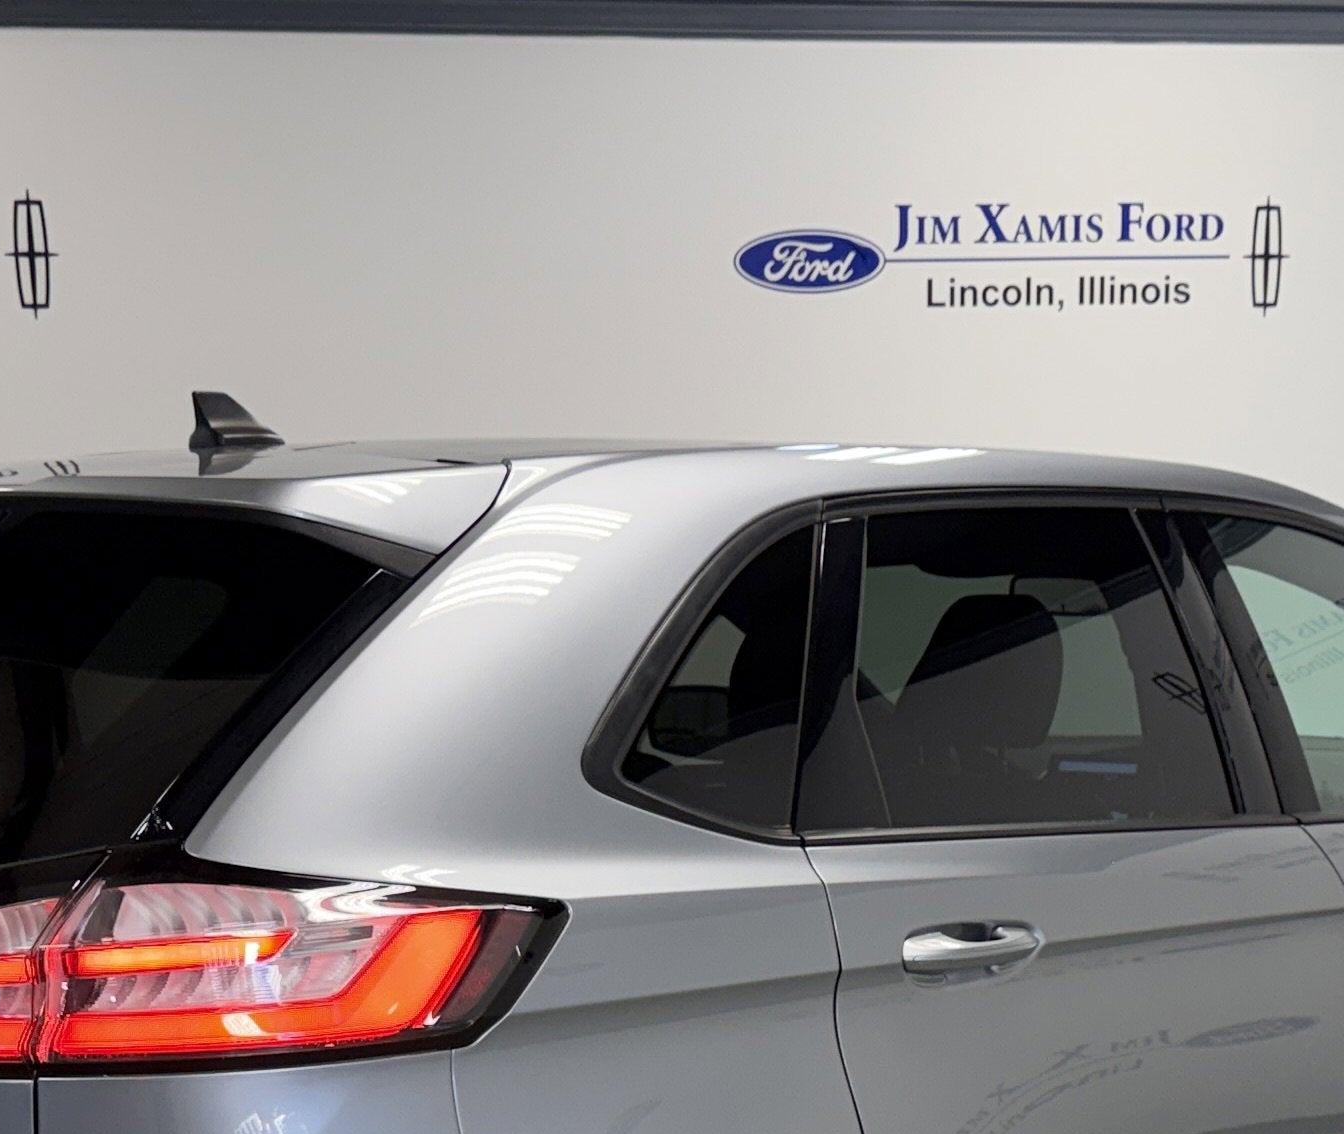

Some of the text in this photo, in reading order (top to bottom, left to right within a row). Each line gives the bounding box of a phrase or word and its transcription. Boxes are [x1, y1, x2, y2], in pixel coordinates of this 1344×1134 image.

[894, 203, 1223, 252] JIM XAMIS FORD
[765, 240, 855, 282] Ford
[928, 276, 1190, 310] Lincoln, Illinois
